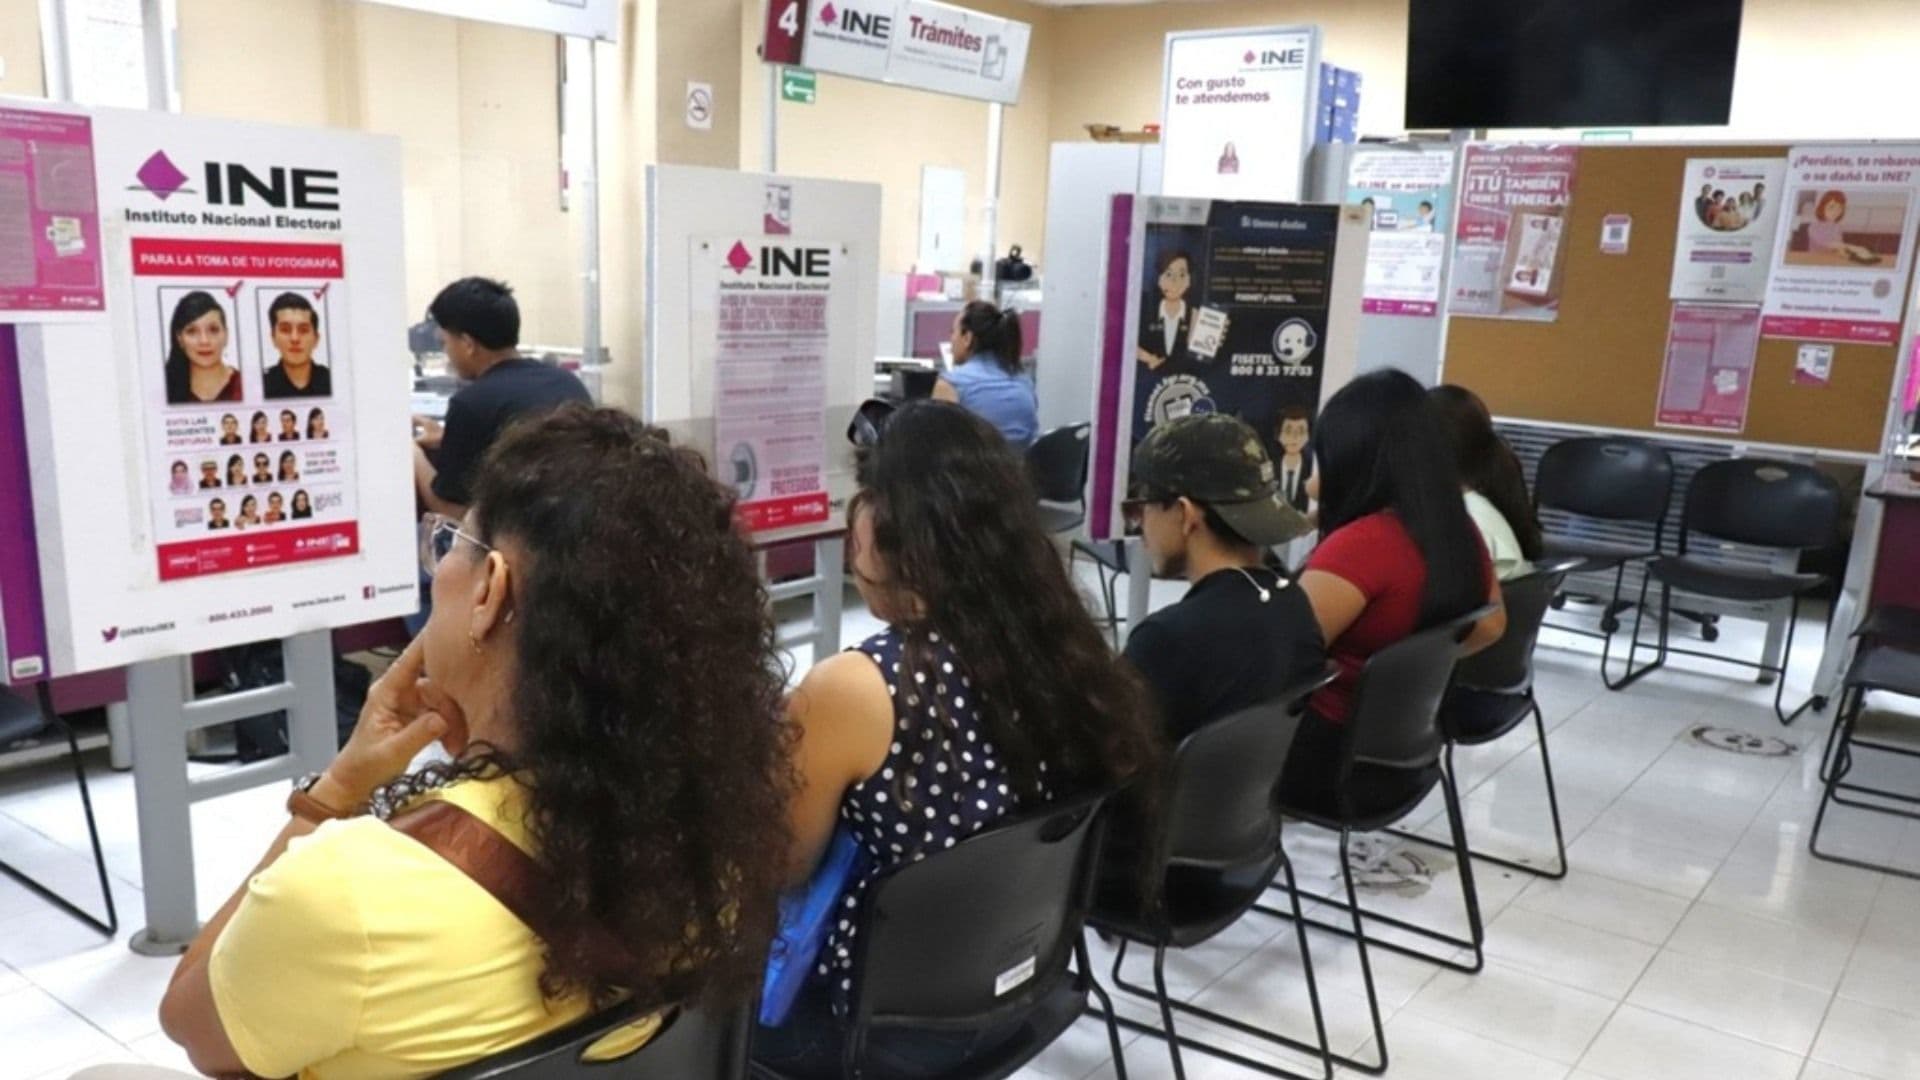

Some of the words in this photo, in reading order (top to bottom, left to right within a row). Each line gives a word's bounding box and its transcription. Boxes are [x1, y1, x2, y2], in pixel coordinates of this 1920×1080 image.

[778, 1, 801, 38] 4
[841, 8, 891, 40] INE
[909, 15, 983, 53] Trámites
[1260, 48, 1304, 65] INE
[1176, 77, 1203, 90] Con
[1206, 76, 1246, 91] gusto
[1175, 93, 1189, 105] te
[1192, 91, 1271, 105] atendemos
[1793, 155, 1855, 169] ¿Perdiste,
[1858, 156, 1871, 166] te
[1802, 173, 1811, 181] o
[1814, 173, 1827, 181] se
[1829, 171, 1863, 182] dañó
[1865, 172, 1879, 182] tu
[1882, 171, 1911, 182] INE?
[204, 161, 340, 210] INE
[125, 208, 197, 224] Instituto
[202, 212, 271, 227] Nacional
[275, 216, 341, 230] Electoral
[140, 253, 174, 265] PARA
[176, 254, 193, 266] LA
[195, 254, 229, 267] TOMA
[231, 256, 248, 267] DE
[249, 256, 266, 268] TU
[268, 256, 339, 269] FOTOGRAFÍA
[760, 246, 831, 277] INE
[719, 281, 756, 291] Instituto
[758, 281, 793, 291] Nacional
[795, 281, 830, 291] Electoral
[1232, 353, 1275, 365] FISETEL
[1230, 366, 1253, 376] 800
[167, 436, 213, 447] POSTURAS
